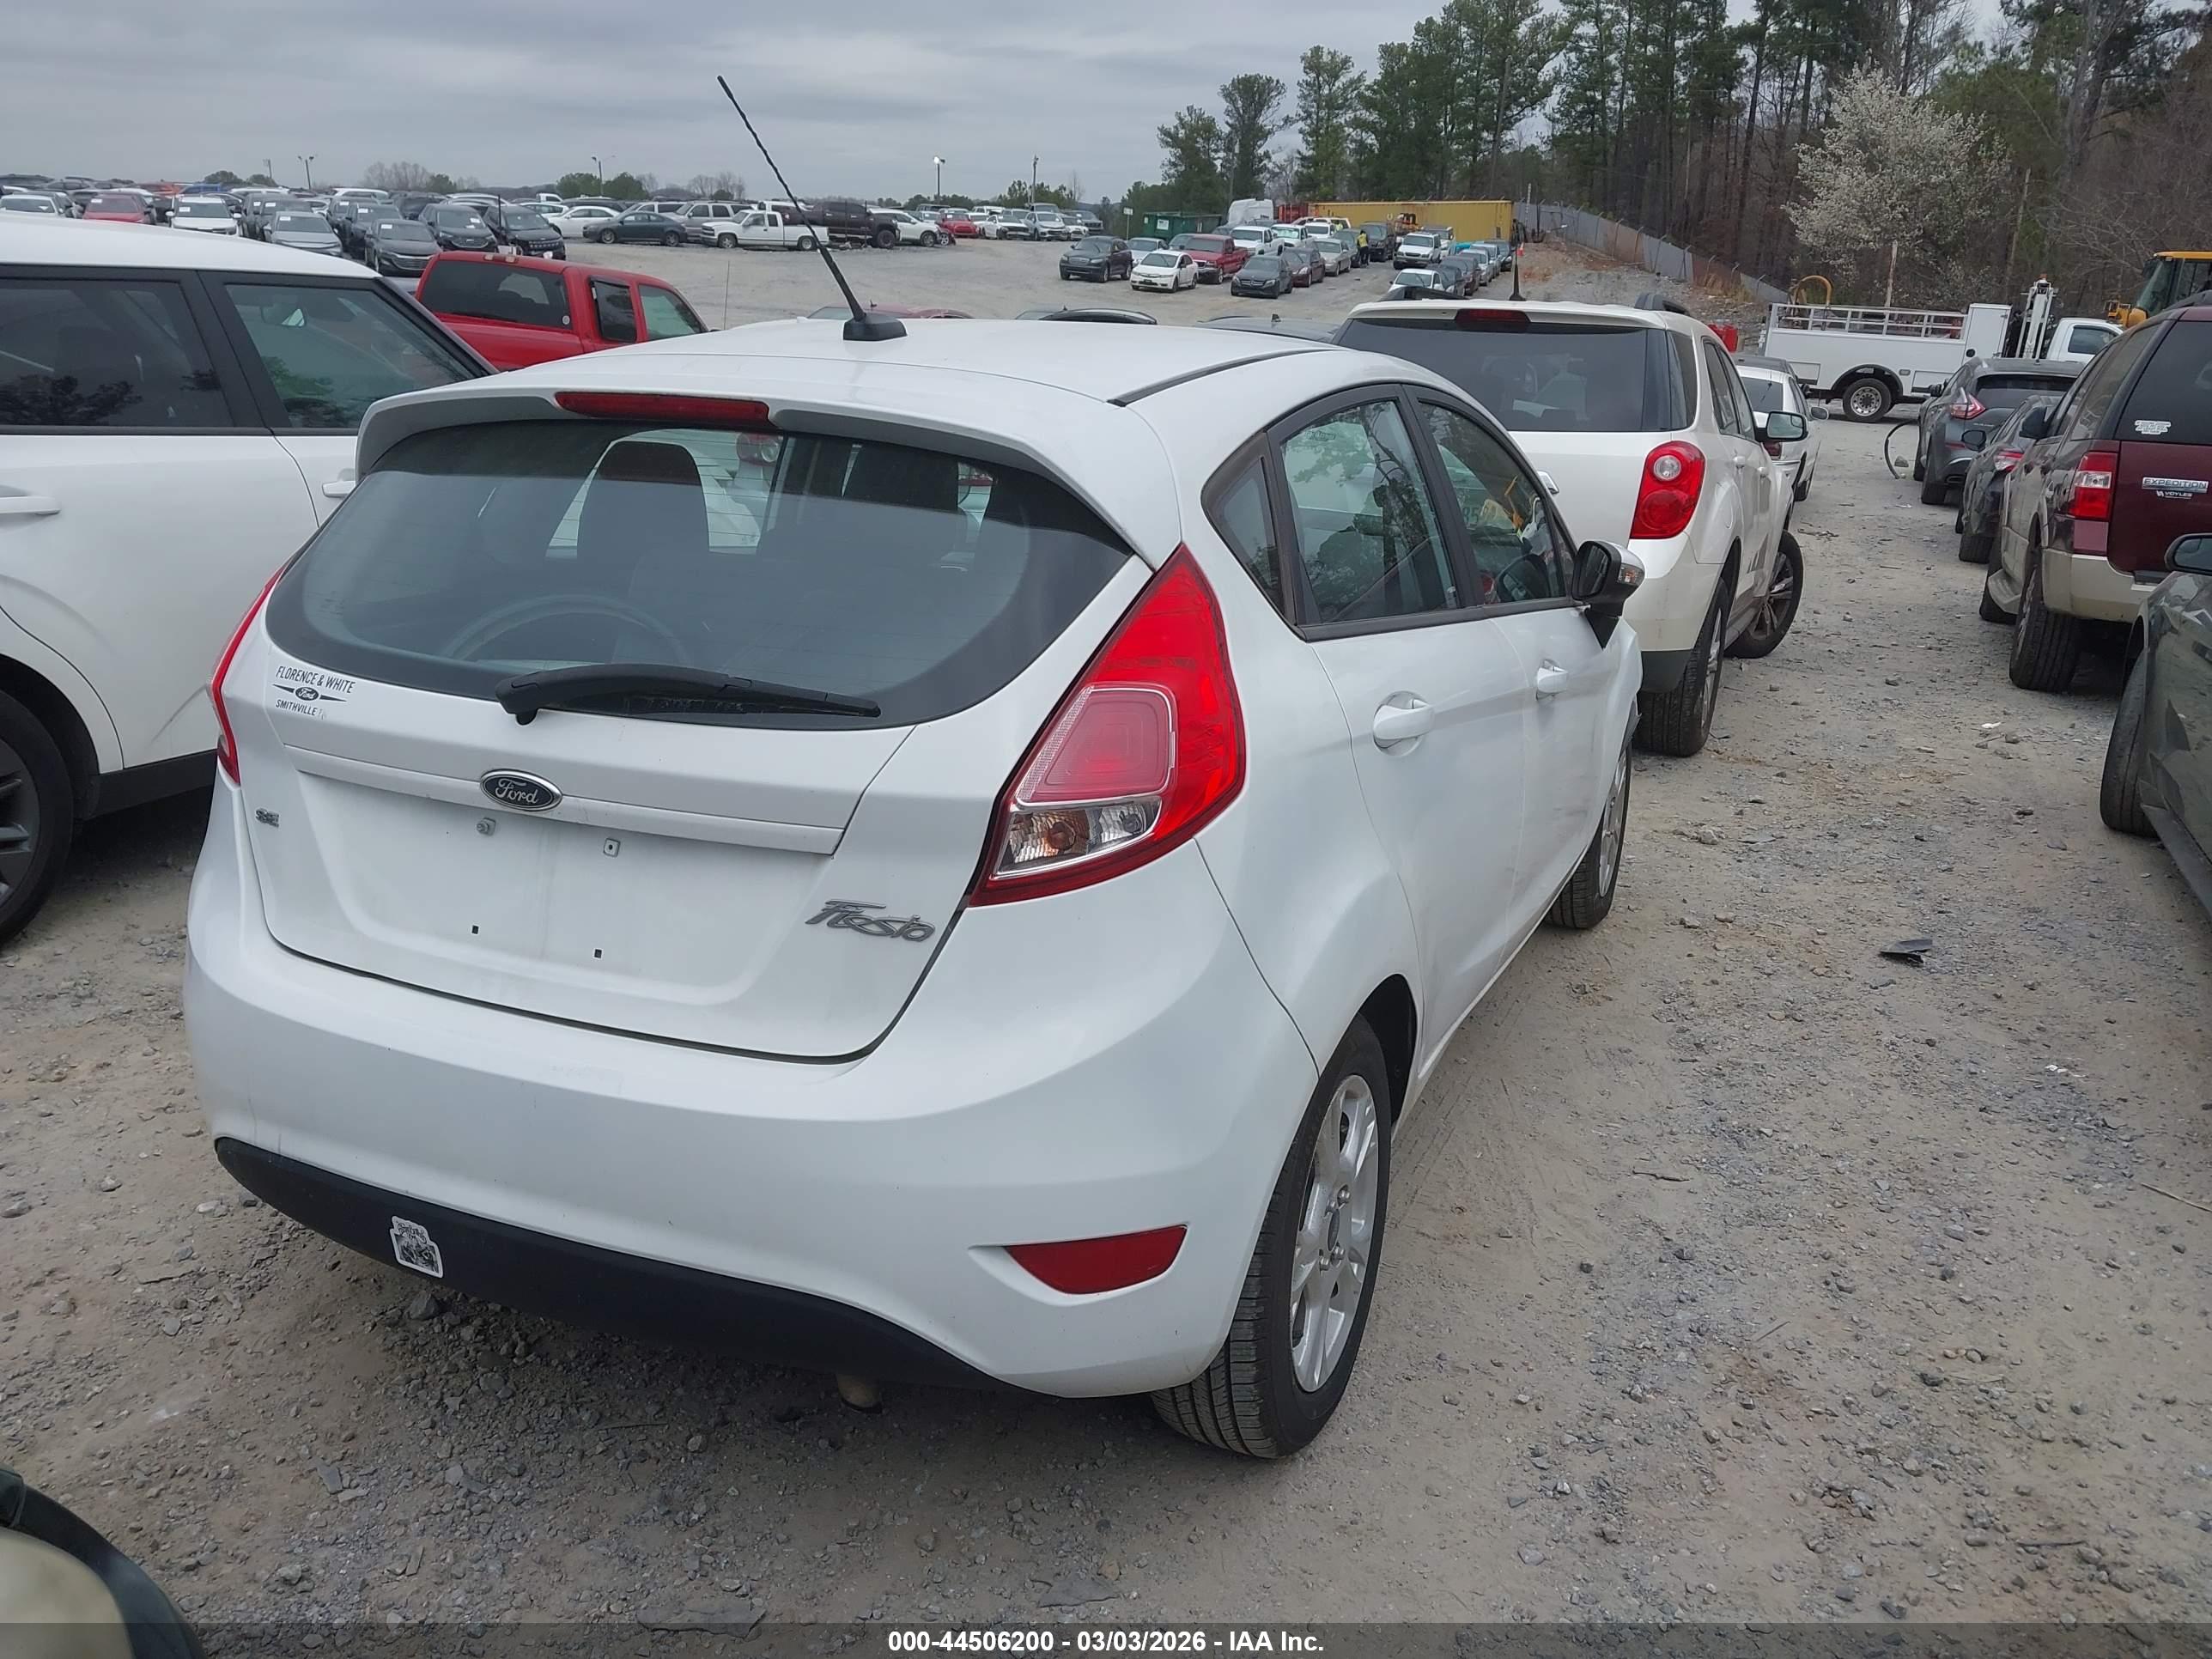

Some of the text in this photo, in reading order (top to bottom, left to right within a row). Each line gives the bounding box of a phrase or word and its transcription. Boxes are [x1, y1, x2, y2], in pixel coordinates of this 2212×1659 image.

[2144, 478, 2207, 489] EXPEDITION
[276, 665, 356, 694] FLORENCE & WHITE
[275, 699, 318, 716] SMITHVILLE
[495, 778, 539, 804] Ford
[255, 808, 280, 828] SE
[805, 899, 936, 942] Fiesta
